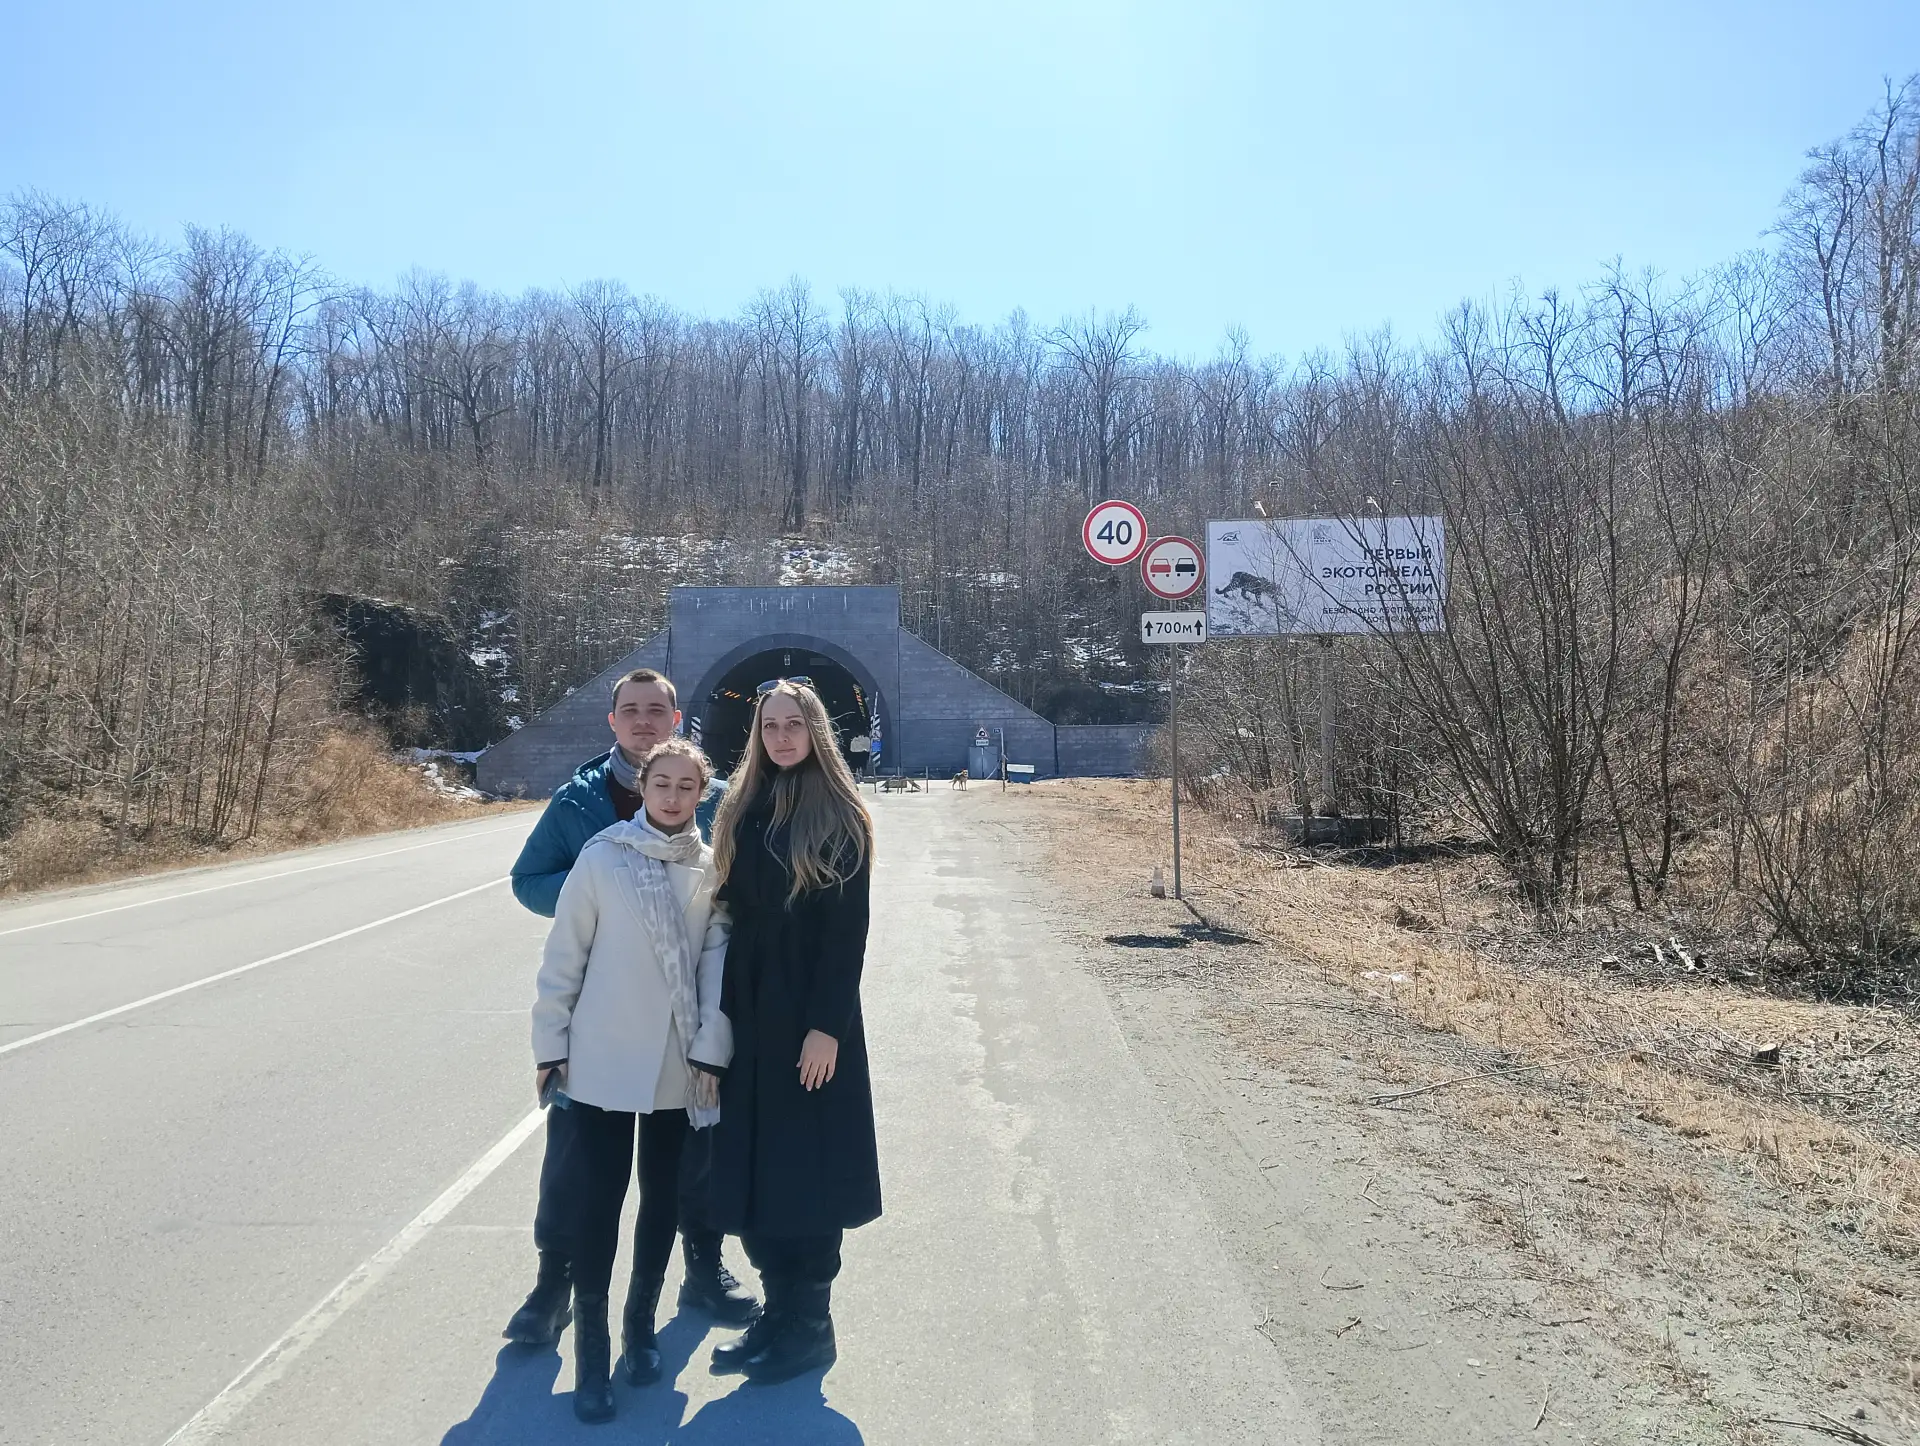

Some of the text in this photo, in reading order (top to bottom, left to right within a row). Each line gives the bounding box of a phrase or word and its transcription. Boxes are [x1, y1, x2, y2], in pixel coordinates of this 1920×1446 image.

[1097, 520, 1132, 545] 40
[1363, 545, 1432, 560] ПЕРВЫЙ
[1322, 566, 1432, 578] ЭКОТОННЕЛЬ
[1365, 583, 1433, 595] РОССИИ
